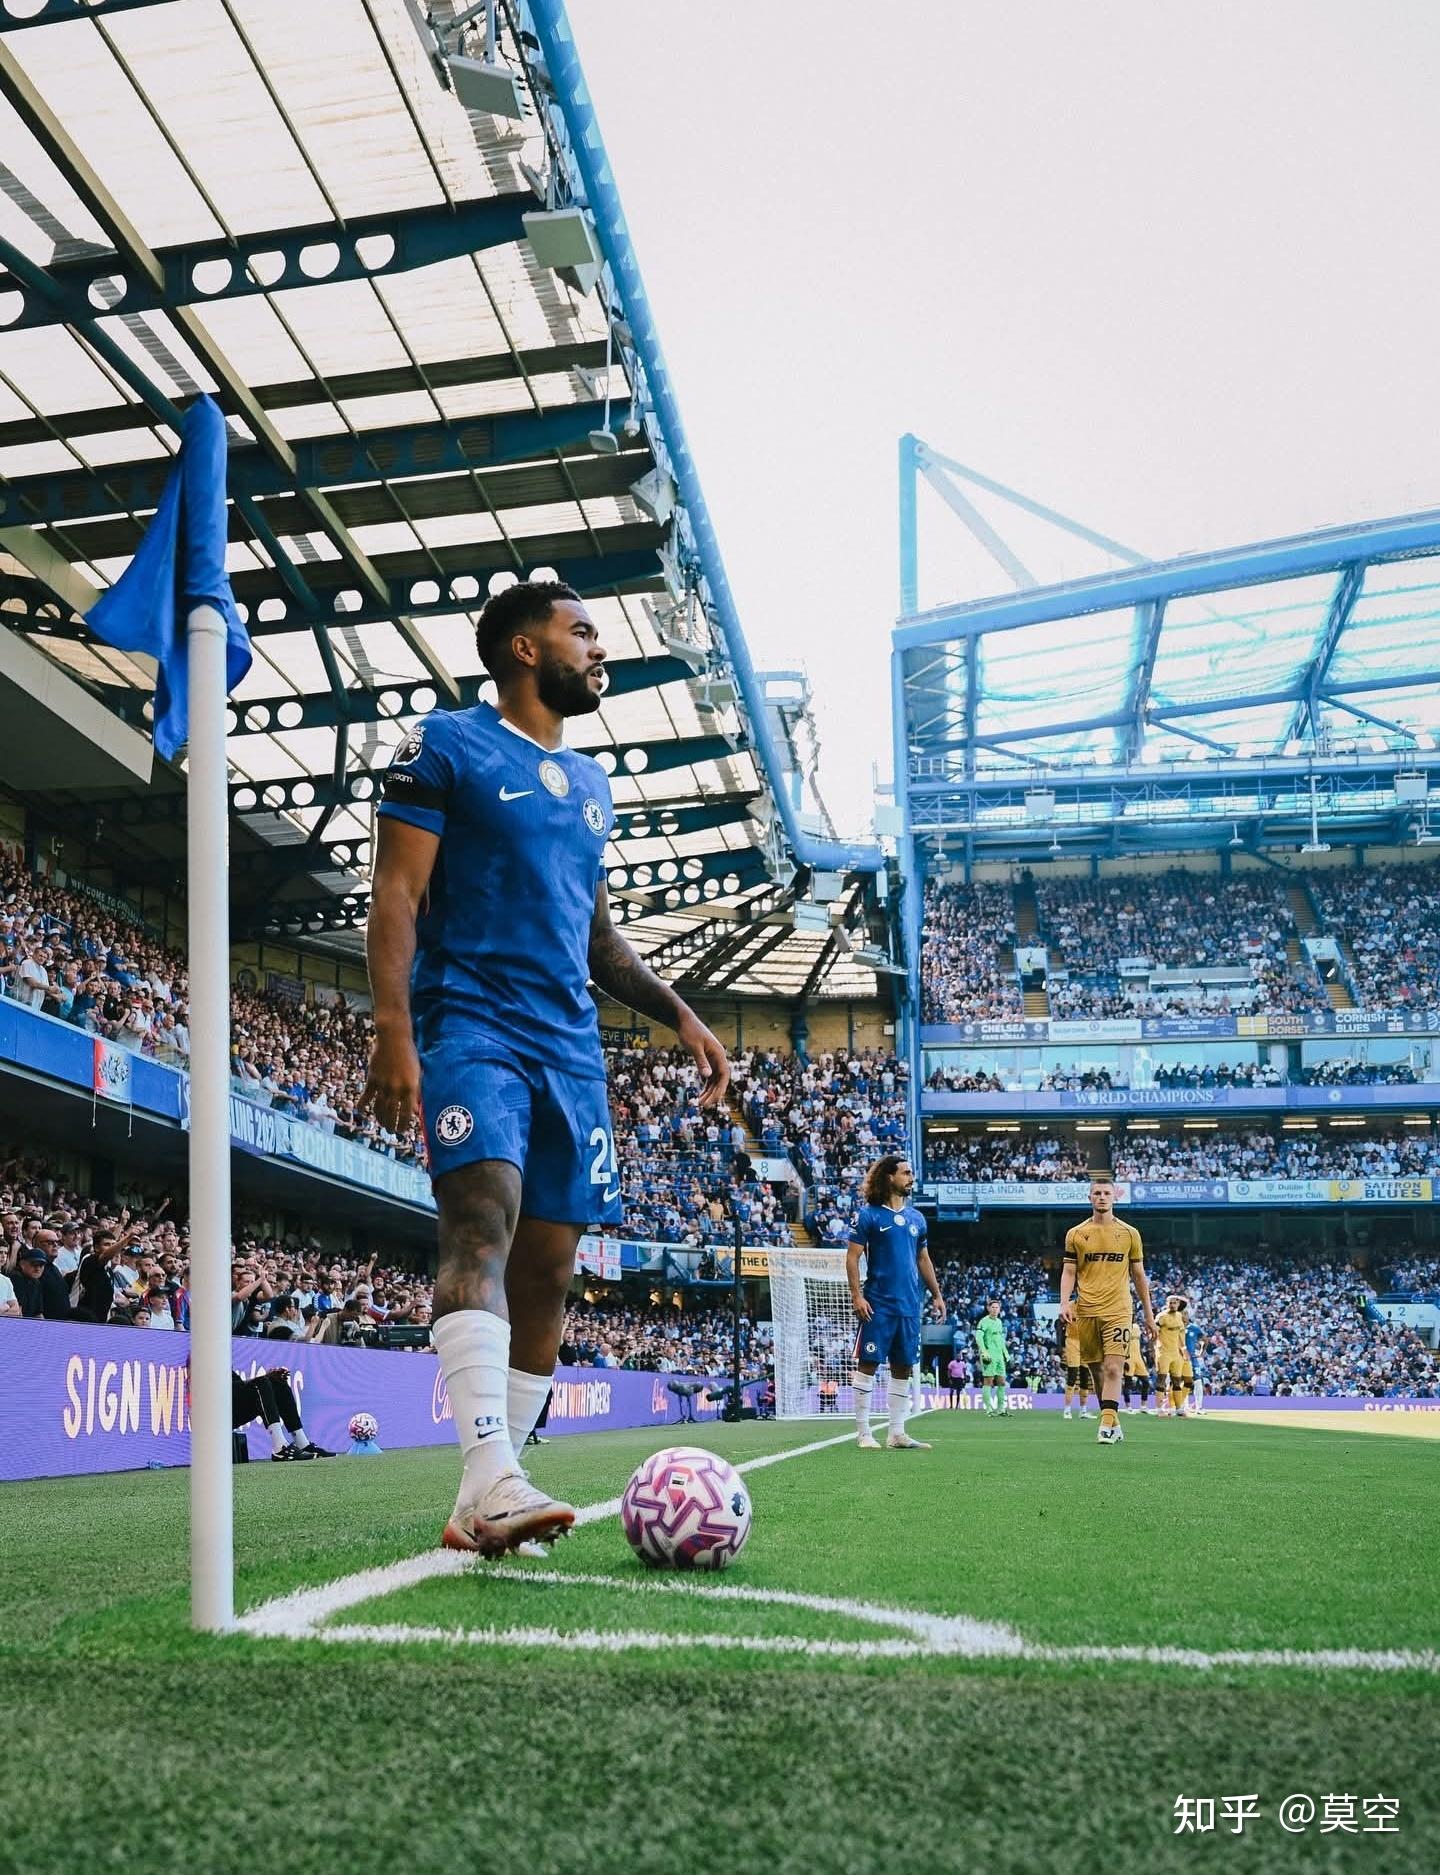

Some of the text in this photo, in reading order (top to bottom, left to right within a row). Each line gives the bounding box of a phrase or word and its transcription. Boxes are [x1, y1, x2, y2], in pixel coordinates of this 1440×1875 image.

[1268, 1016, 1303, 1025] SOUTH
[1335, 1013, 1385, 1023] CORNISH
[981, 1023, 1026, 1033] CHELSEA
[1268, 1025, 1309, 1034] DORSET
[1335, 1022, 1370, 1033] BLUES
[1129, 1090, 1215, 1103] CHAMPIONS
[946, 1185, 1025, 1194] CHELSEA INDIA
[1365, 1181, 1421, 1189] SAFFRON
[1365, 1189, 1422, 1198] BLUES
[741, 1256, 759, 1267] THE
[1399, 1306, 1406, 1317] 2
[1113, 1327, 1131, 1344] 20
[64, 1355, 141, 1439] SIGN
[148, 1361, 191, 1437] WI
[568, 1382, 586, 1419] WITH
[475, 1416, 504, 1427] CFC
